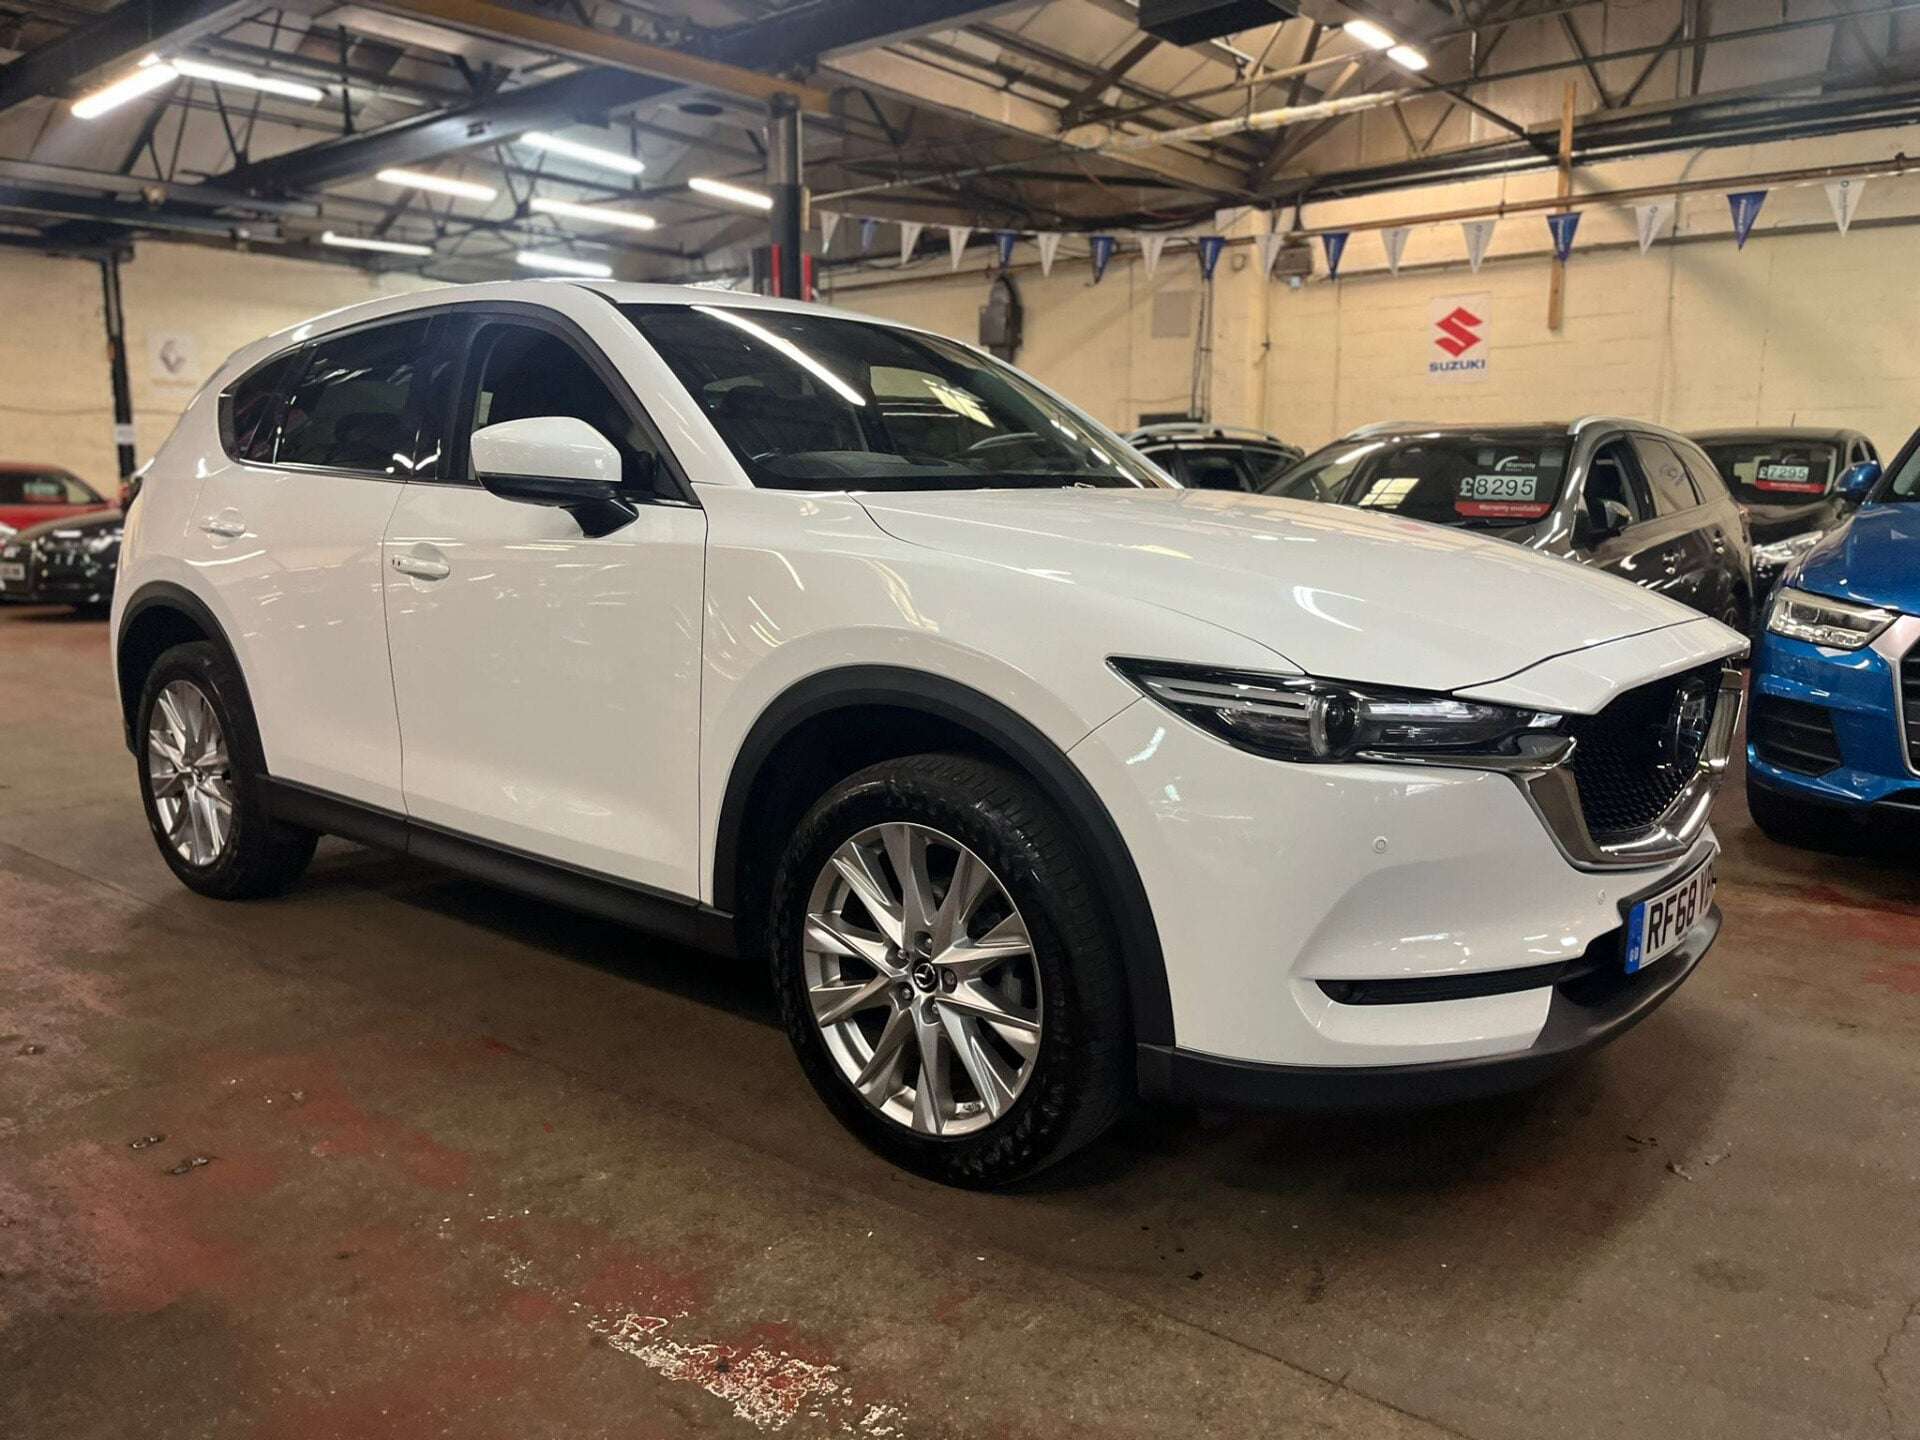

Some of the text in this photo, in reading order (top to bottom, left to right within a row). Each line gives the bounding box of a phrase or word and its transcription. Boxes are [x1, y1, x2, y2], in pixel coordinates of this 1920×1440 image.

[1429, 359, 1485, 372] SUZUKI
[1460, 477, 1534, 497] £8295
[1646, 879, 1697, 954] RF68
